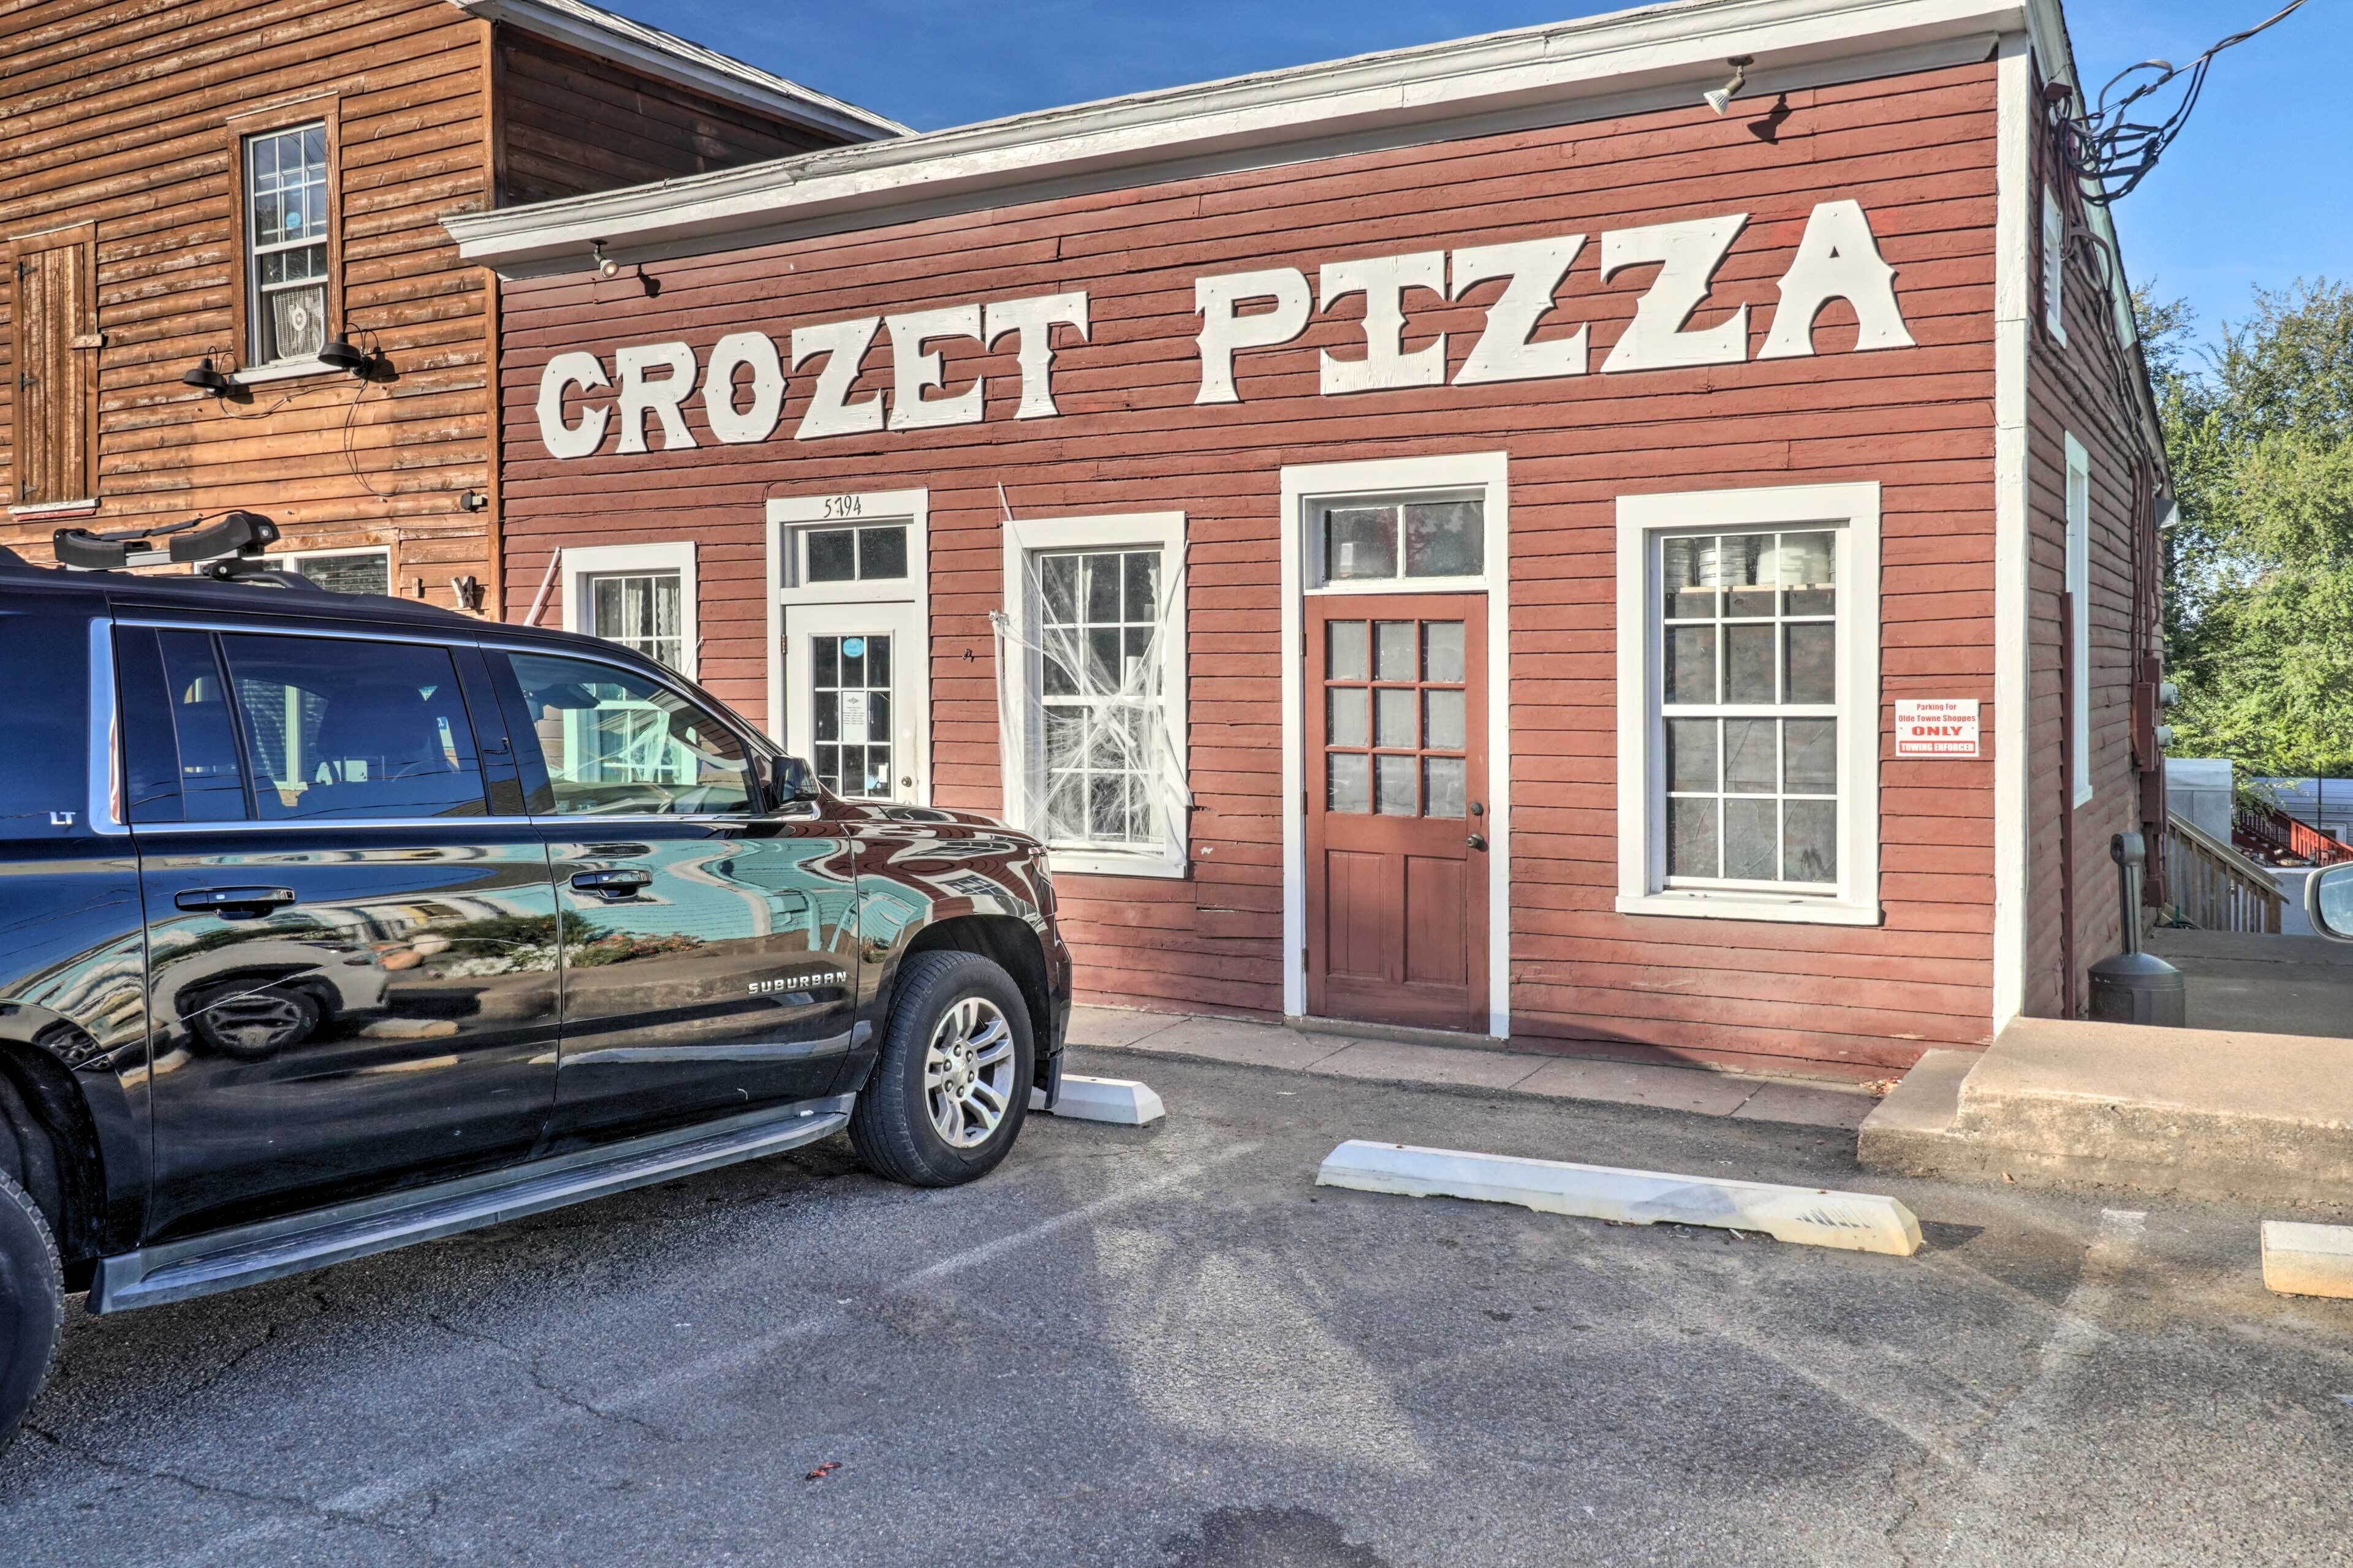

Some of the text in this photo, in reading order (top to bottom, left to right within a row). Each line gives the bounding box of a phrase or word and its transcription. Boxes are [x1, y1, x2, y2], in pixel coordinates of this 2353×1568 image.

[535, 198, 1916, 458] CROZET PIZZA
[824, 495, 861, 518] 5794
[1912, 726, 1963, 736] ONLY
[1901, 743, 1933, 751] TOWING
[50, 811, 76, 825] LT
[748, 971, 846, 994] SUBURBAN
